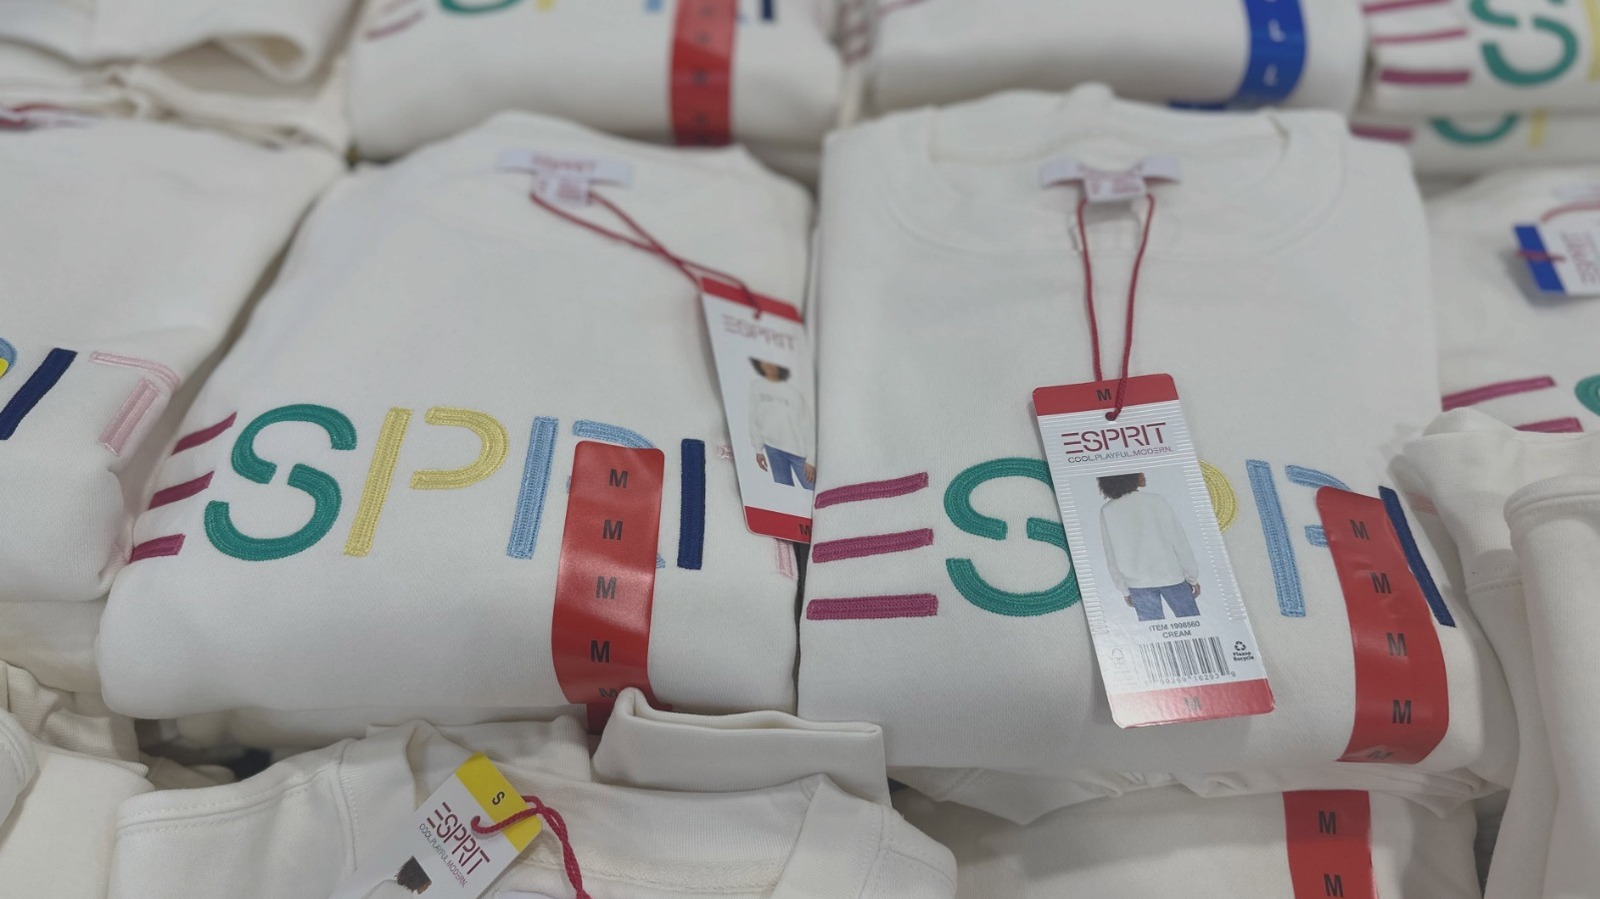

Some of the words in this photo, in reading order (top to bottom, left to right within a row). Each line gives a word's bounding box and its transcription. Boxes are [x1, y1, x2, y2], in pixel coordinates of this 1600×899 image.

[1096, 388, 1112, 401] M
[1061, 421, 1166, 455] ESPRIT
[608, 468, 629, 489] M
[602, 519, 624, 541] M
[1349, 519, 1370, 541] M
[595, 576, 618, 600] M
[1370, 572, 1392, 595] M
[1148, 623, 1168, 632] ITEM
[1162, 630, 1192, 639] CREAM
[590, 640, 611, 664] M
[1386, 632, 1408, 657] M
[1392, 698, 1413, 725] M
[491, 791, 506, 806] S
[1318, 810, 1337, 835] M
[426, 801, 491, 875] ESPRIT
[1323, 873, 1345, 898] M
